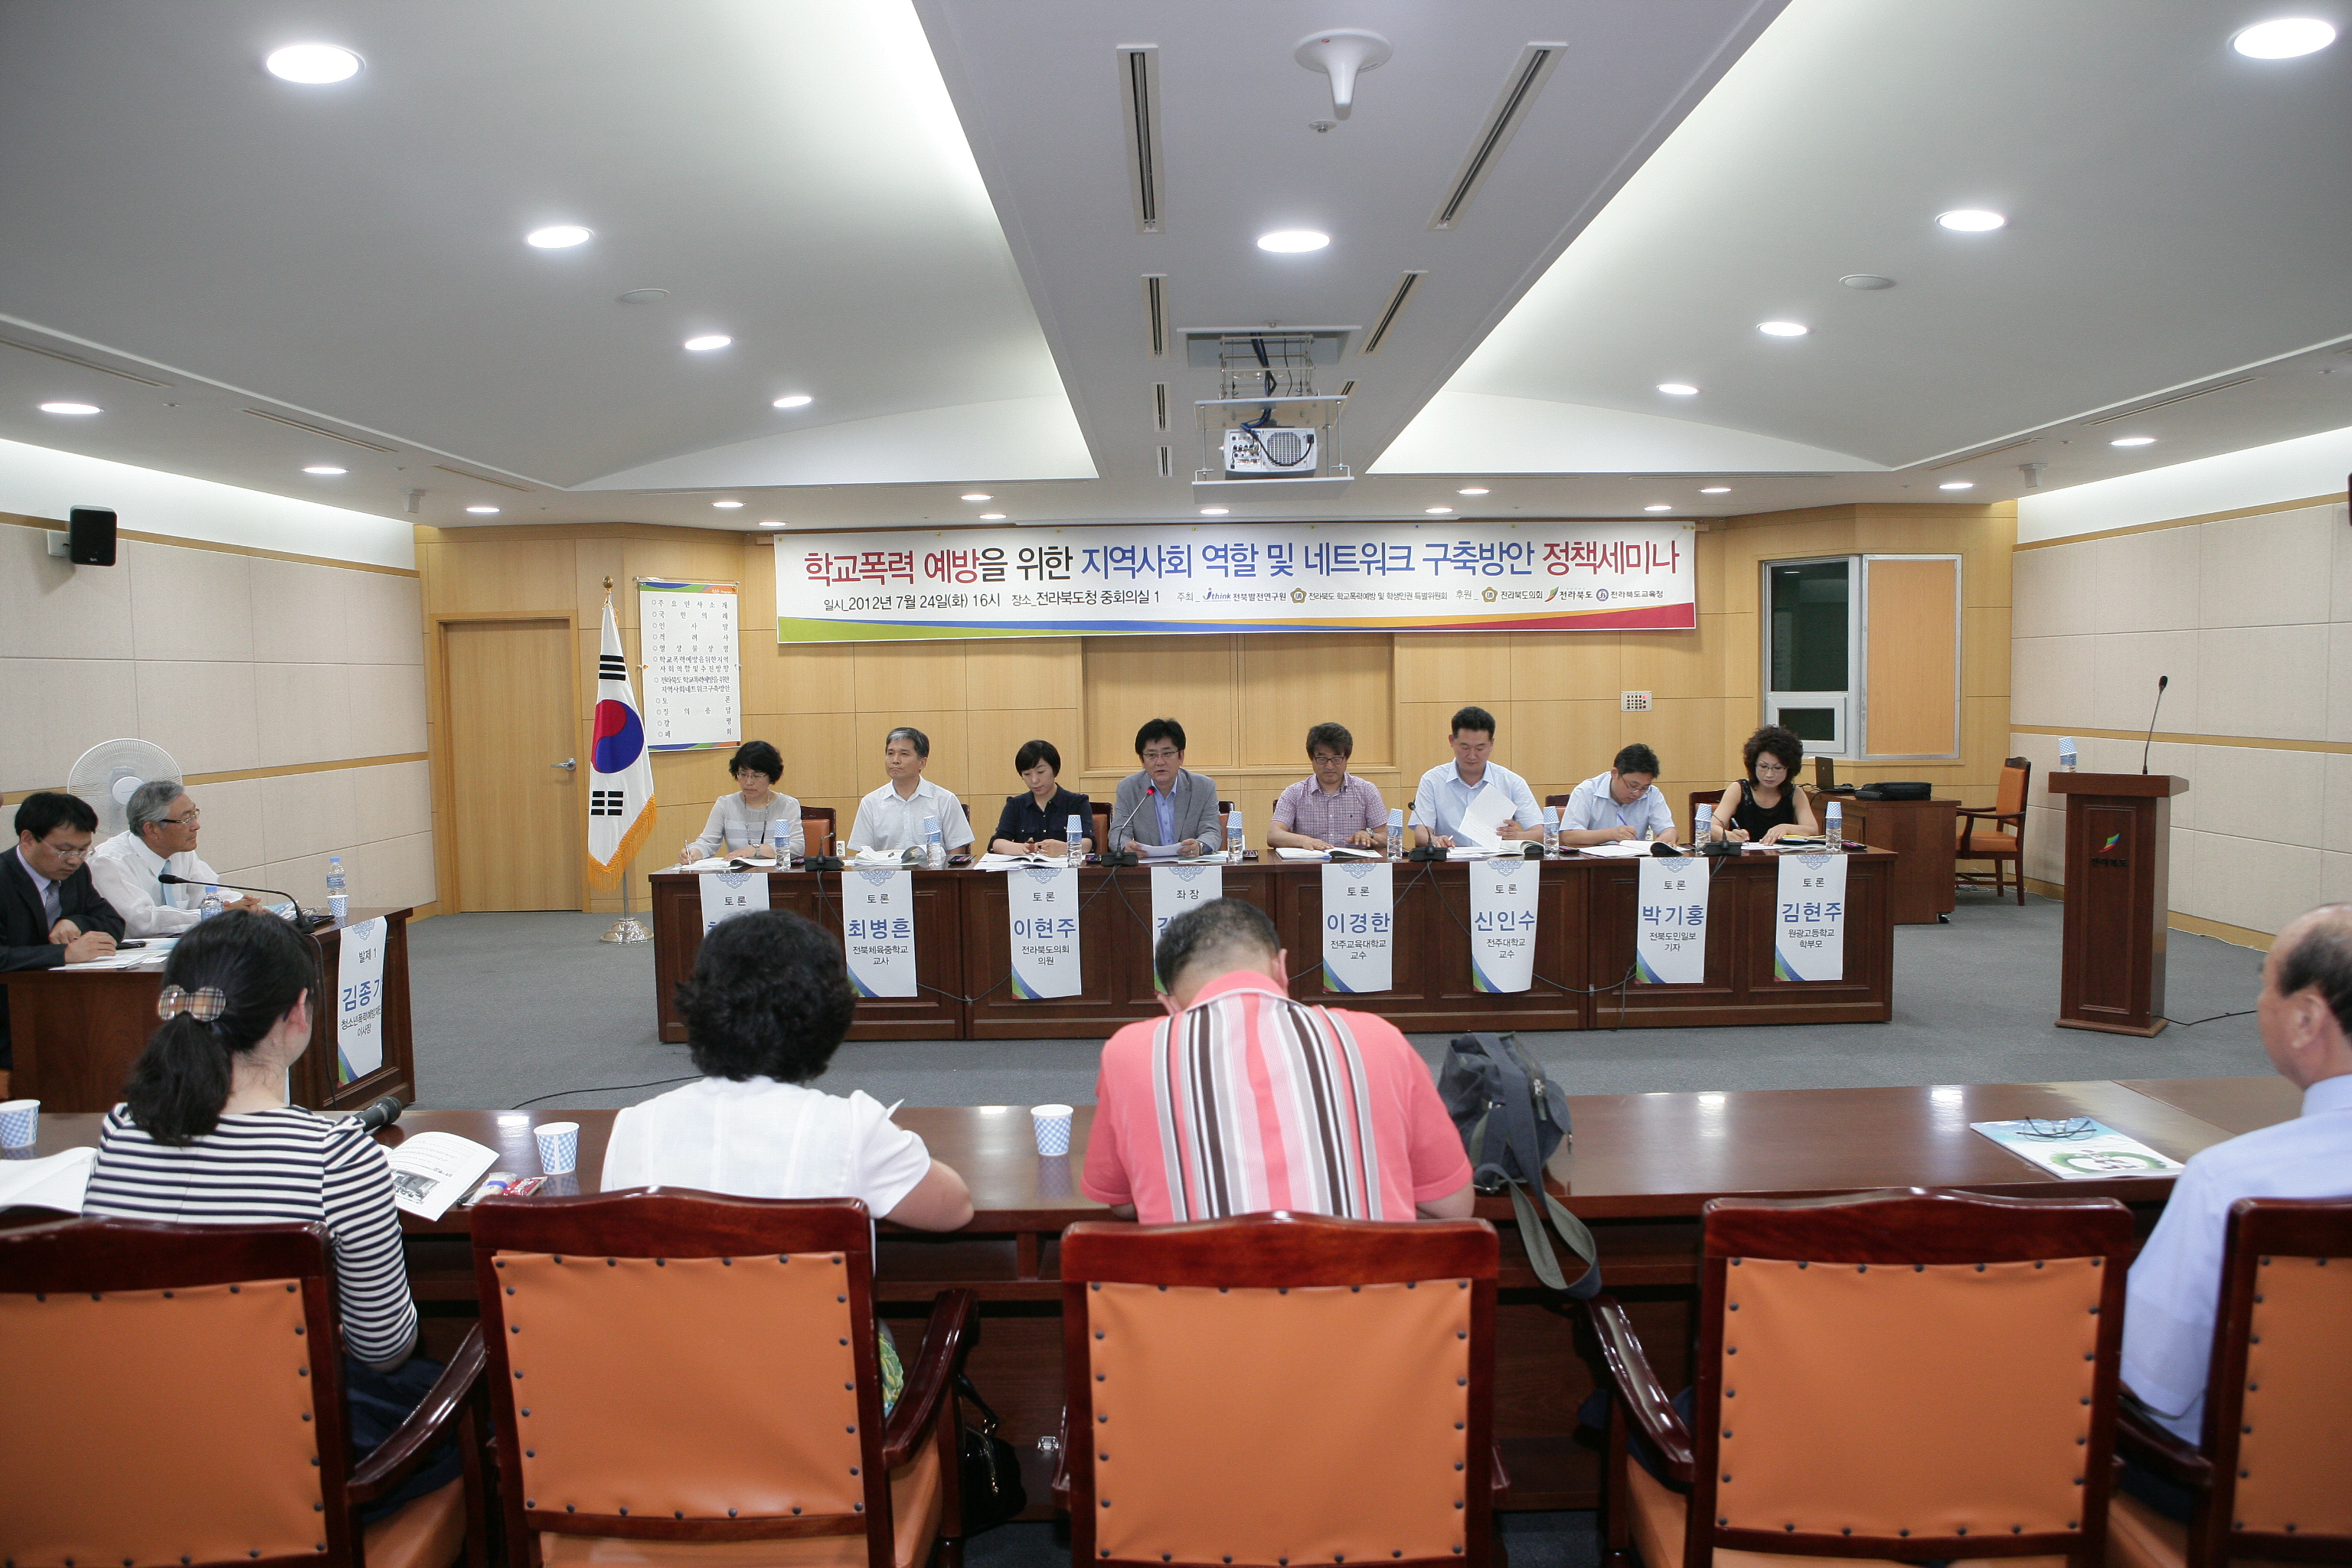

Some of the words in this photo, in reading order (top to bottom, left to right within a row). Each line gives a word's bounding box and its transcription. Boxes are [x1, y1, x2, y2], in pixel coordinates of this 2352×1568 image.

[804, 550, 914, 586] 학교폭력
[924, 547, 1008, 584] 예방을
[1017, 546, 1073, 582] 위한
[1082, 544, 1191, 580] 지역사회
[1201, 543, 1258, 579] 역할
[1267, 543, 1293, 576] 및
[1305, 542, 1415, 577] 네트워크
[1423, 541, 1535, 577] 구축방안
[1542, 540, 1680, 576] 정책세미나
[1100, 590, 1148, 606] 중회의실
[1154, 590, 1159, 603] 1
[1233, 592, 1286, 602] 전북발전연구원
[1308, 592, 1334, 601] 전라북도
[1337, 592, 1376, 601] 학교폭력예방
[1378, 592, 1384, 601] 및
[1387, 592, 1413, 601] 학생인권
[1414, 591, 1447, 600] 특별위원회
[1501, 590, 1543, 600] 전라북도의회
[1560, 590, 1593, 600] 전라북도
[1611, 590, 1664, 599] 전라북도교육청
[895, 595, 916, 610] 7월
[920, 594, 968, 610] 24일(화)
[972, 593, 1001, 609] 16시
[1642, 903, 1704, 926] 박기홍
[1782, 901, 1842, 923] 김현주
[1327, 913, 1390, 935] 이경한
[1474, 910, 1536, 933] 신인수
[848, 918, 911, 939] 최병흔
[1014, 918, 1076, 939] 이현주
[1788, 928, 1834, 938] 원광고등학교
[1649, 931, 1697, 942] 전북도민일보
[1331, 939, 1387, 949] 전주교육대학교
[1487, 938, 1525, 948] 전주대학교
[1664, 942, 1681, 952] 기자
[1799, 939, 1823, 949] 학부모
[852, 945, 909, 956] 전북체육중학교
[1021, 945, 1070, 955] 전라북도의회
[1498, 949, 1515, 959] 교수
[359, 948, 371, 963] 발제
[873, 956, 889, 965] 교사
[1037, 956, 1054, 965] 의원
[1351, 951, 1367, 960] 교수
